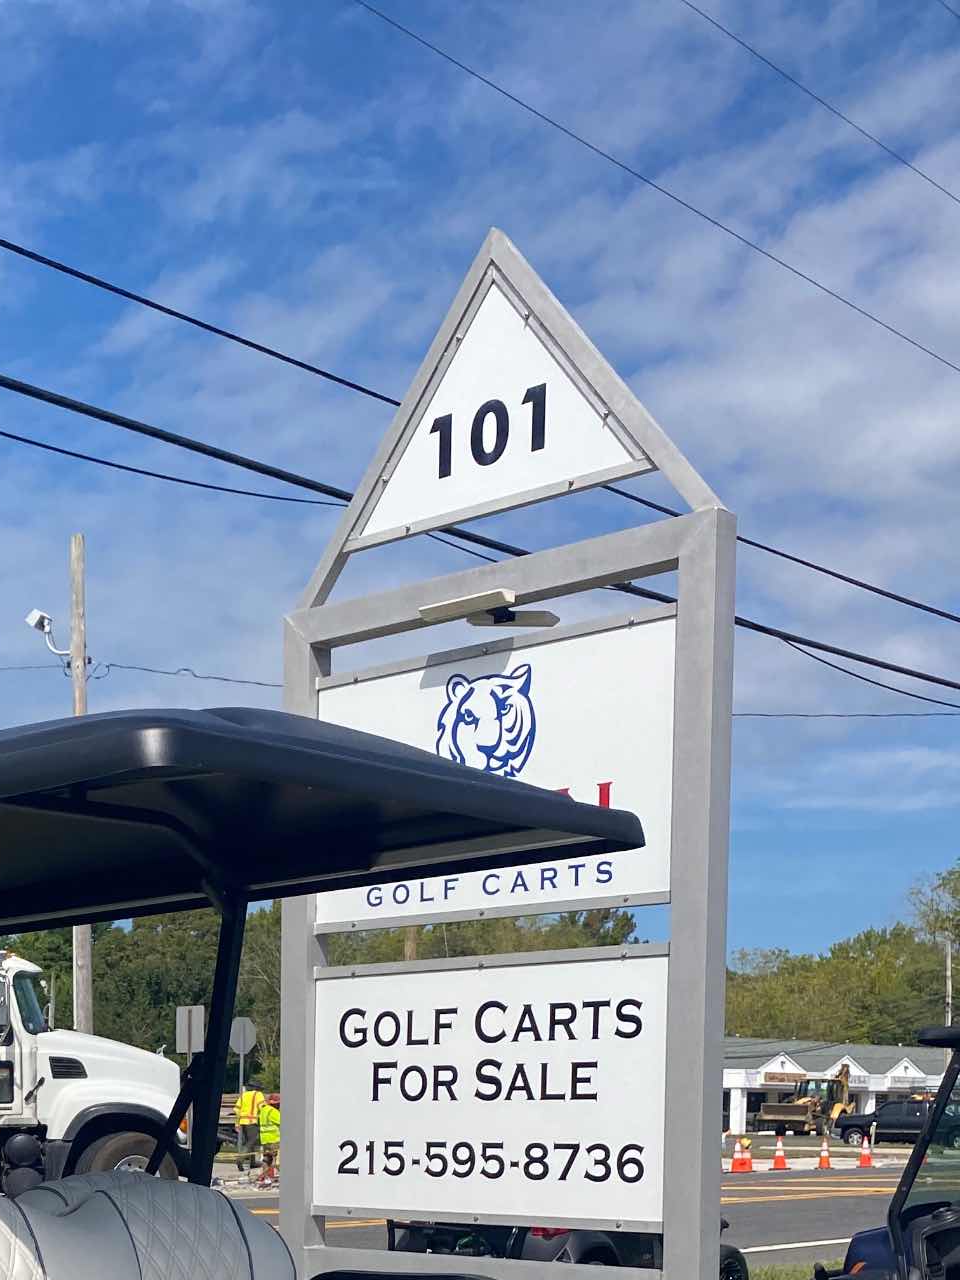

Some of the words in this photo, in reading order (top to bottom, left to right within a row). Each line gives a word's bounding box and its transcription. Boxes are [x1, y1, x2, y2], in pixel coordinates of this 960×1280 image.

[429, 382, 547, 480] 101
[366, 878, 460, 908] GOLF
[482, 860, 614, 896] CARTS
[339, 1007, 459, 1049] GOLF
[473, 998, 643, 1044] CARTS
[371, 1061, 459, 1102] FOR
[473, 1058, 599, 1102] SALE
[337, 1138, 646, 1184] 215-595-8736
